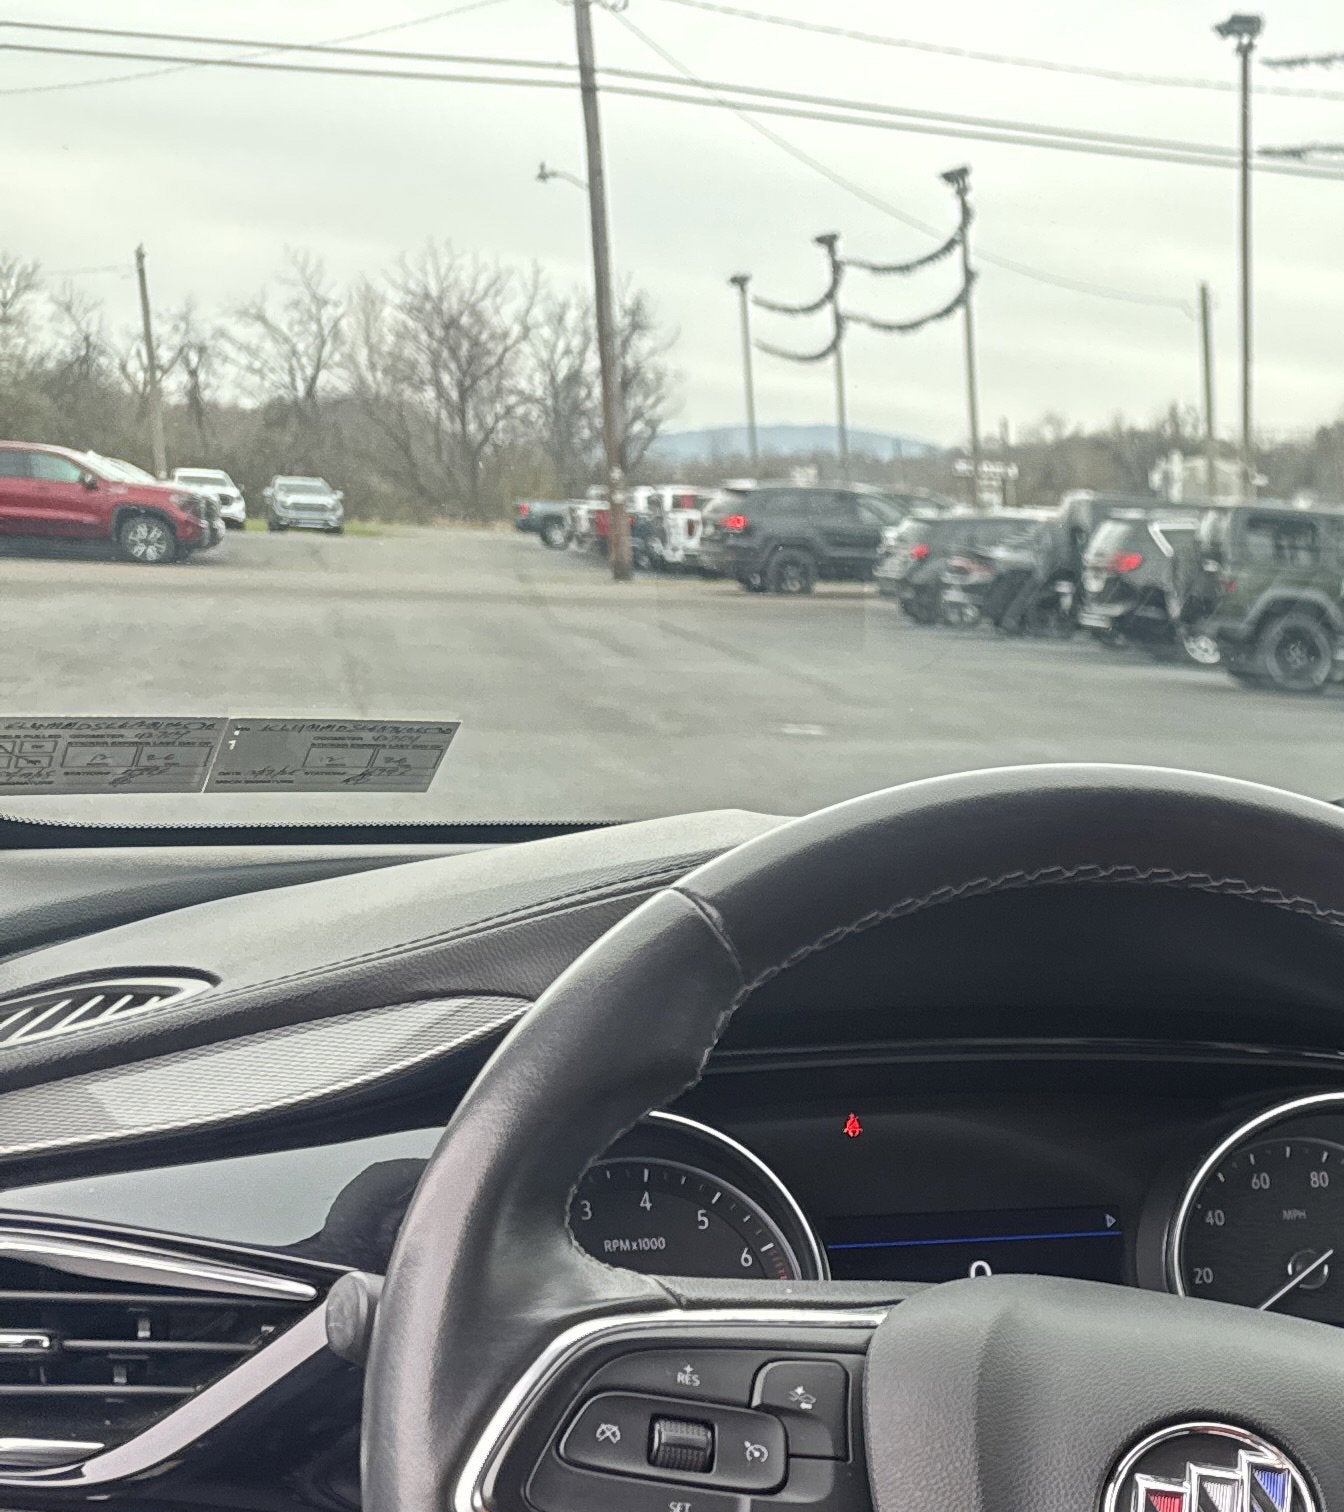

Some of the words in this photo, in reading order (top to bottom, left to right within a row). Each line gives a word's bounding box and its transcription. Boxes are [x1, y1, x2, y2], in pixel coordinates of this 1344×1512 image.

[1251, 1172, 1271, 1190] 60
[1310, 1171, 1329, 1188] 80
[639, 1191, 652, 1211] 4
[580, 1200, 592, 1220] 3
[1205, 1209, 1225, 1226] 40
[1282, 1209, 1307, 1220] MPH
[697, 1209, 709, 1230] 5
[740, 1247, 752, 1267] 6
[1194, 1267, 1214, 1284] 20
[676, 1371, 701, 1387] RES
